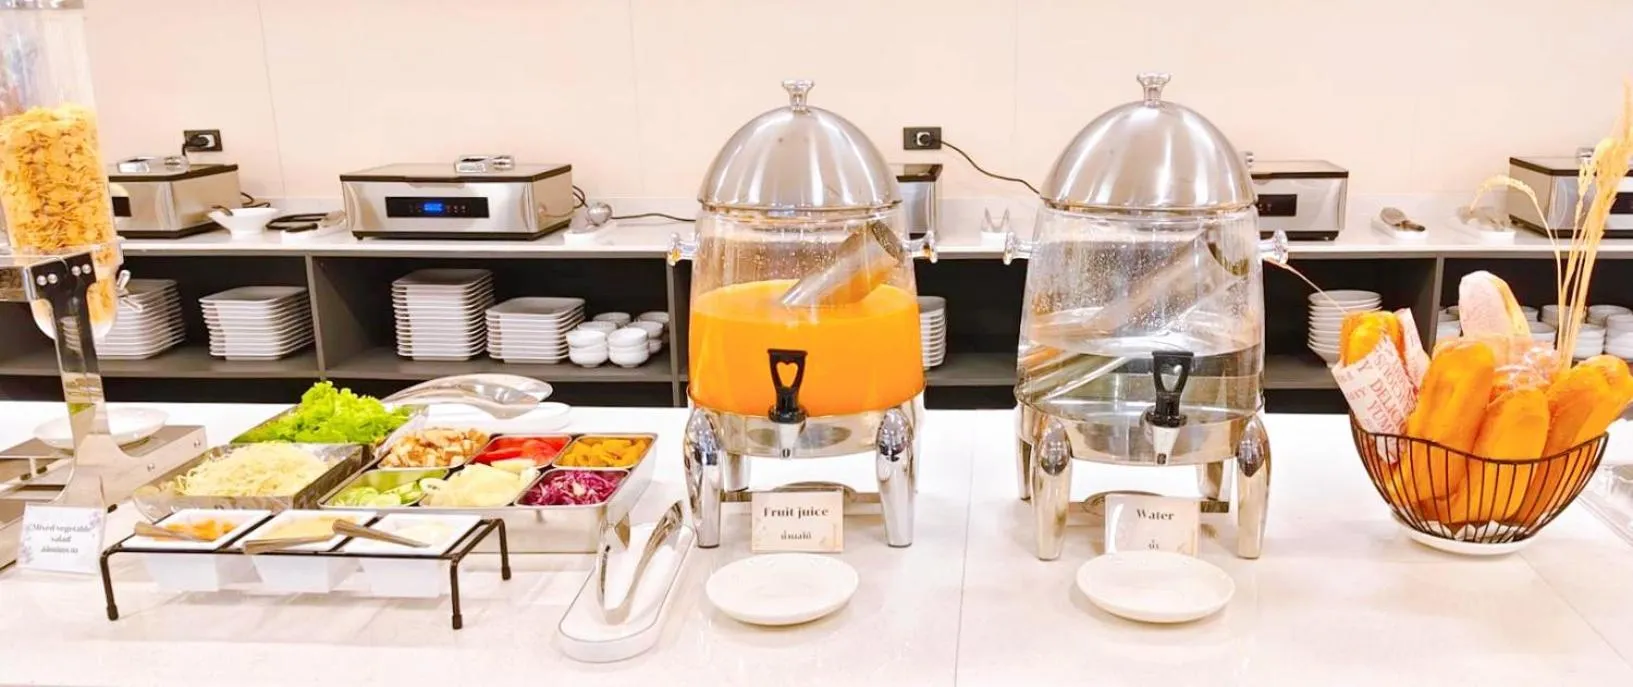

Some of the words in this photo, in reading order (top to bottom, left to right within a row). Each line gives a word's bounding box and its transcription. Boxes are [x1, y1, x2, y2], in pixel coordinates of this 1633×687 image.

[763, 505, 794, 517] Fruit
[797, 504, 829, 519] juice
[1136, 508, 1175, 520] Water
